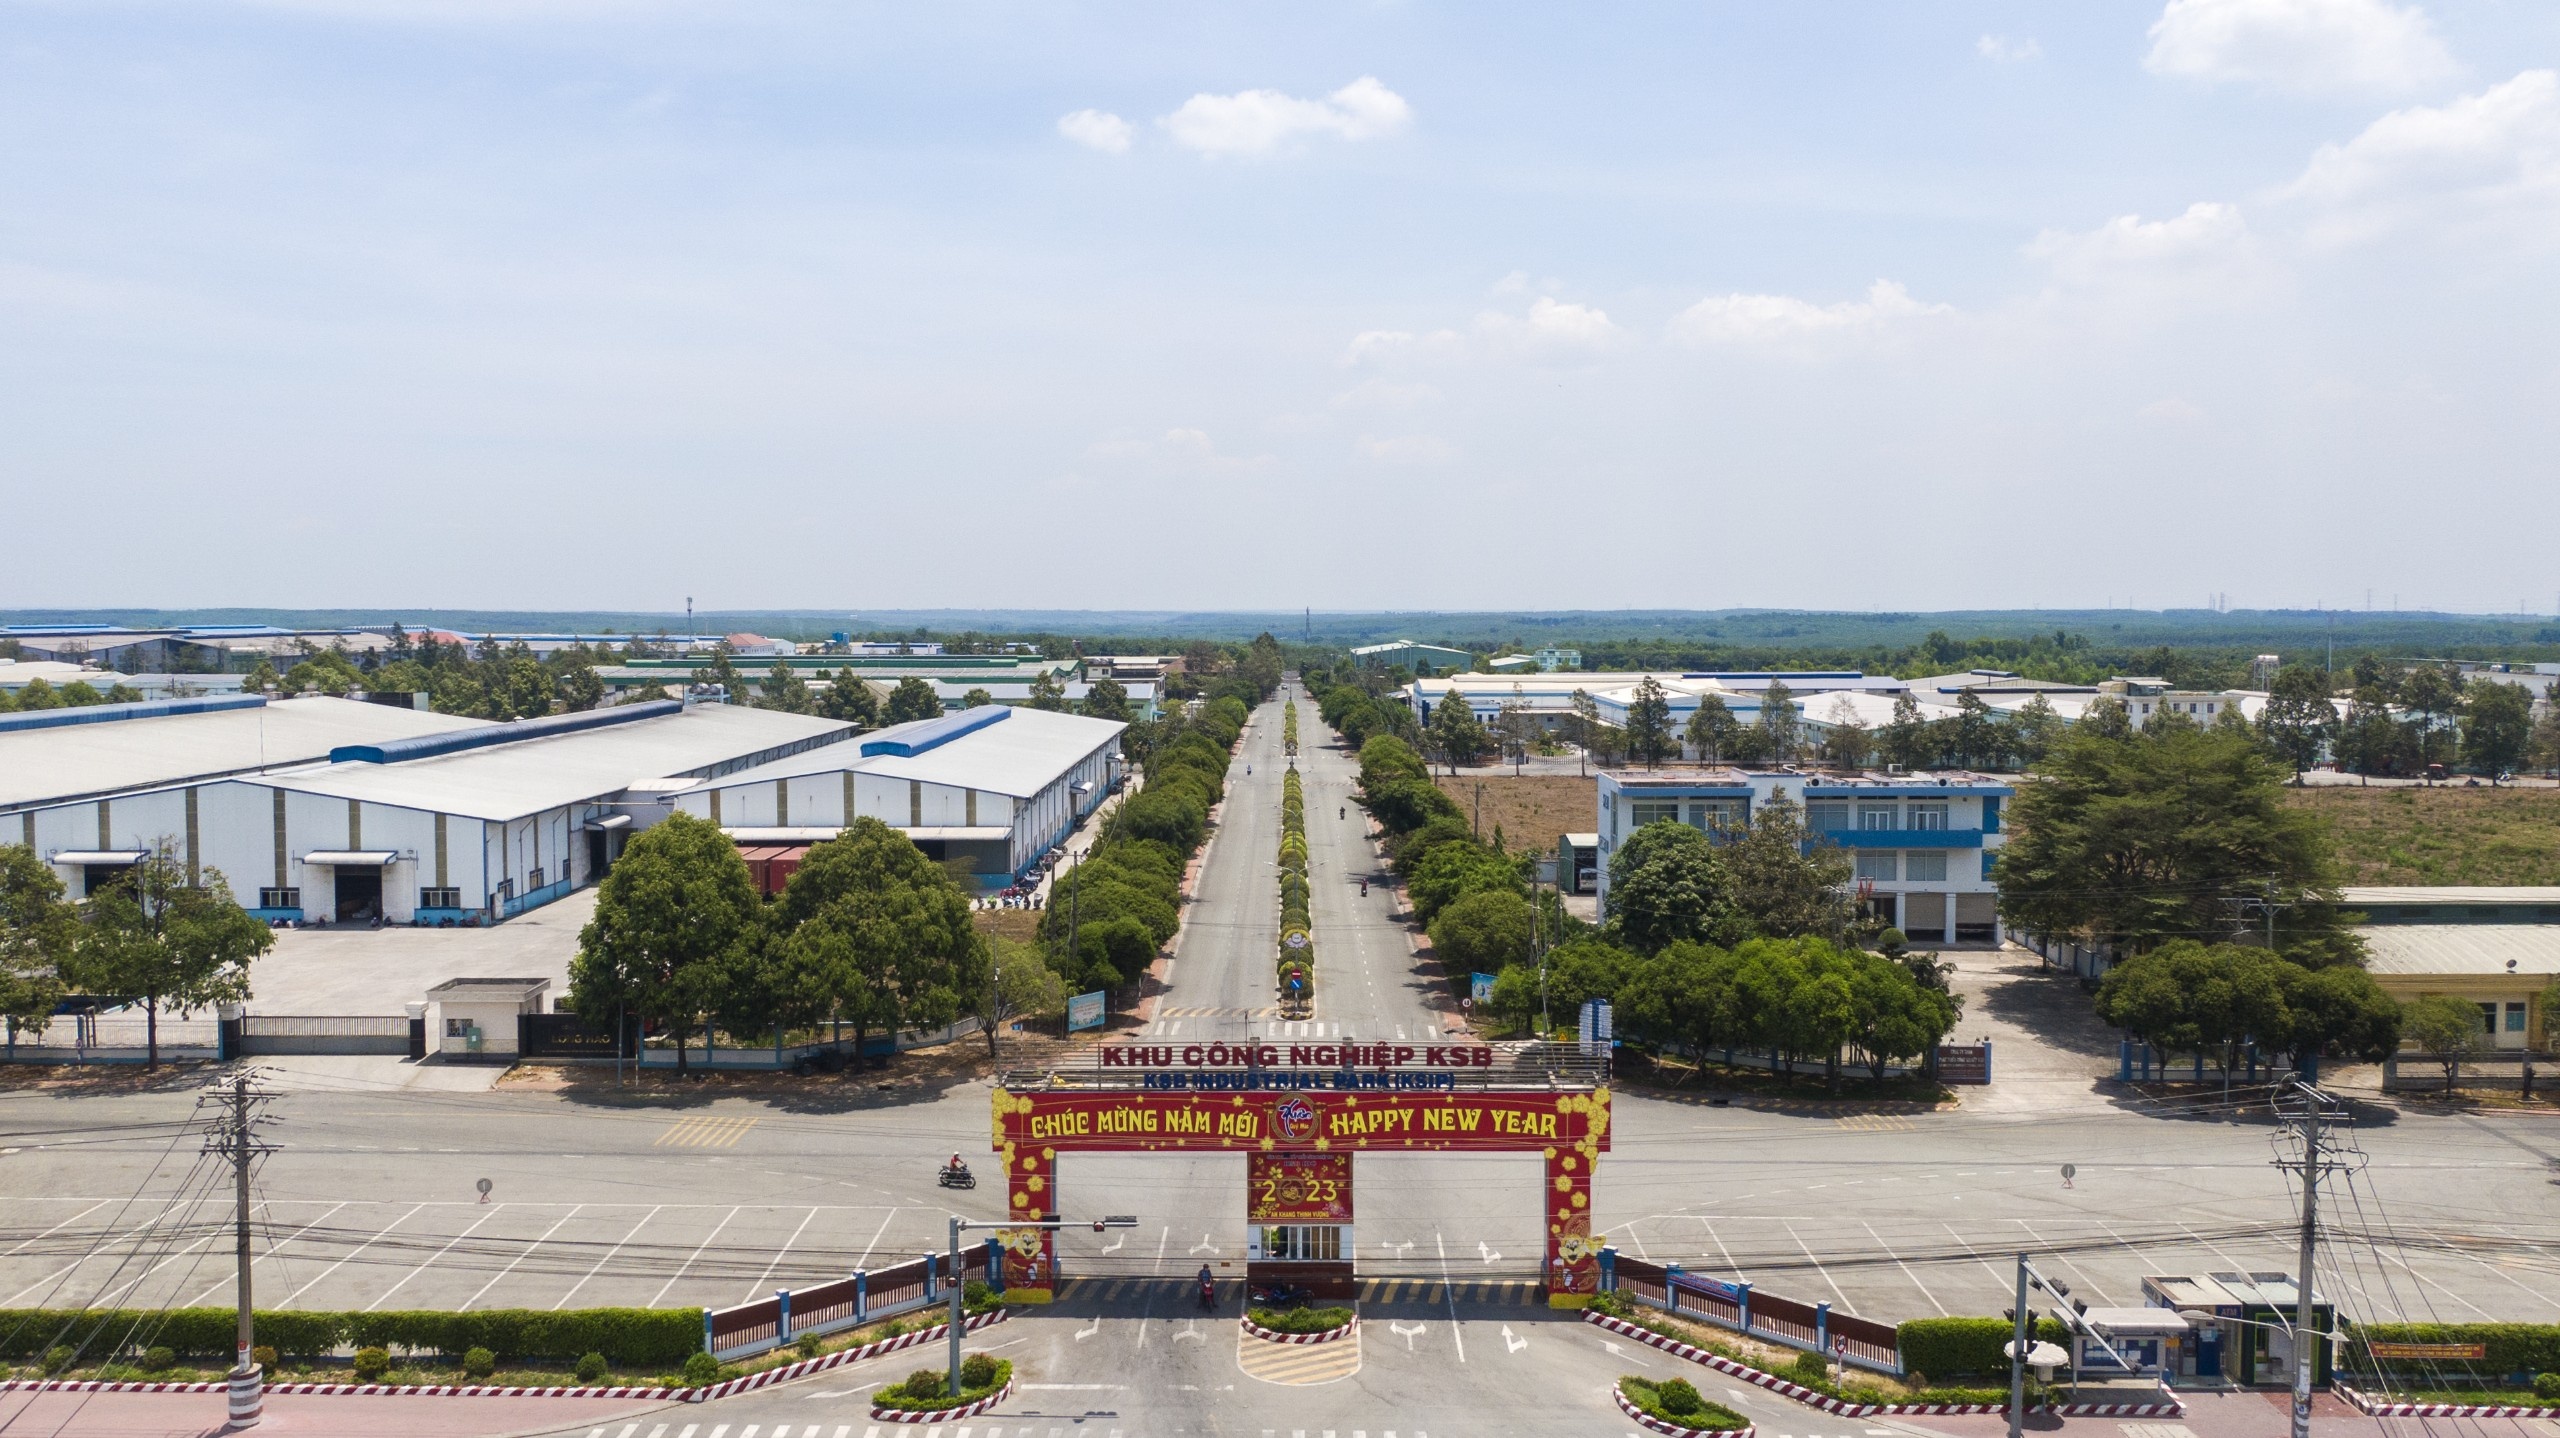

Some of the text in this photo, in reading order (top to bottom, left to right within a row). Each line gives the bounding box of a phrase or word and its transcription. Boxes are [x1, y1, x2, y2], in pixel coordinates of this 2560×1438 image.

[1103, 1040, 1493, 1073] KHU CÔNG NGHIỆP KSB
[1143, 1071, 1456, 1091] KSB INDUSTRIAL PARK (KSIP)
[1031, 1104, 1259, 1138] CHÚC MỪNG NĂM MỚI
[1329, 1108, 1557, 1139] HAPPY NEW YEAR
[2220, 1307, 2237, 1317] ATM
